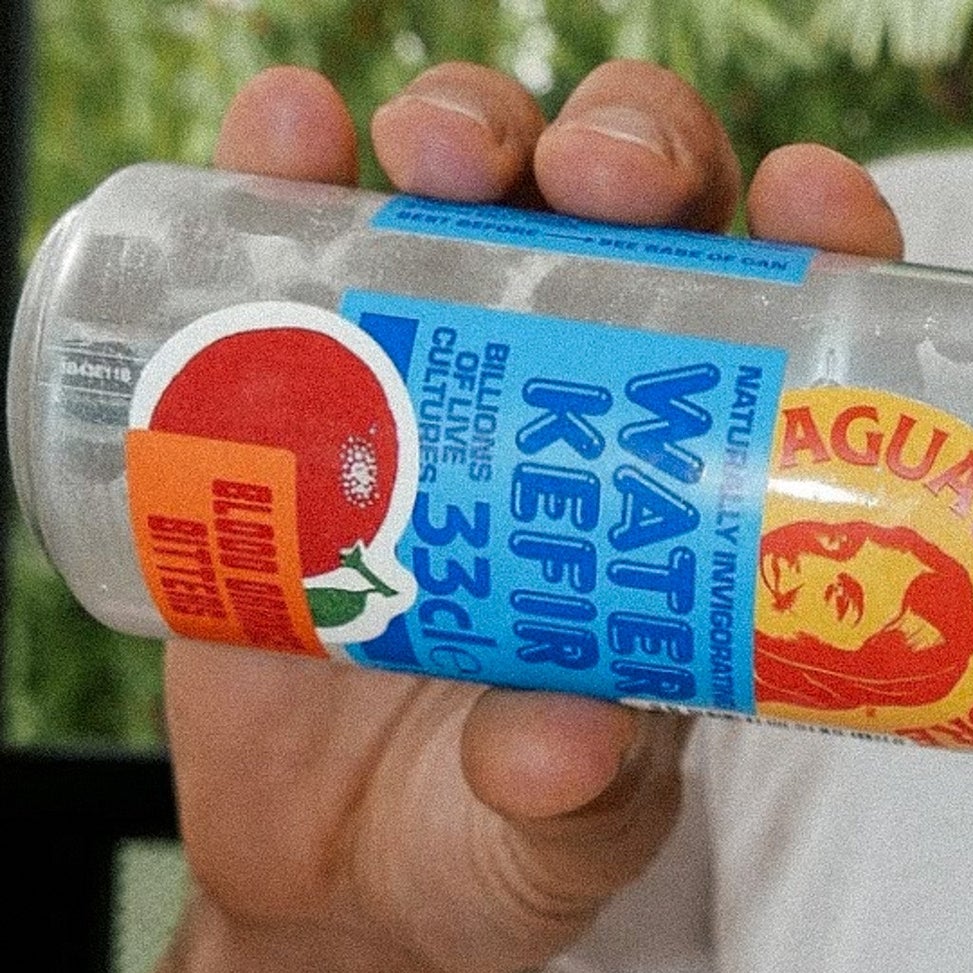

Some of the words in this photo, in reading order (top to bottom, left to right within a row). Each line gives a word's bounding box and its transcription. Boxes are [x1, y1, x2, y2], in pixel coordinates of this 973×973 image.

[742, 256, 790, 271] CAN
[419, 326, 458, 484] CULTURES
[441, 397, 473, 465] LIVE
[453, 351, 480, 392] OF
[469, 341, 511, 482] BILLIONS
[714, 364, 763, 547] NATURLLY
[147, 514, 228, 620] BITTERS
[211, 478, 280, 575] BLOOD
[508, 377, 613, 670] KEFIR
[605, 363, 721, 700] WATER
